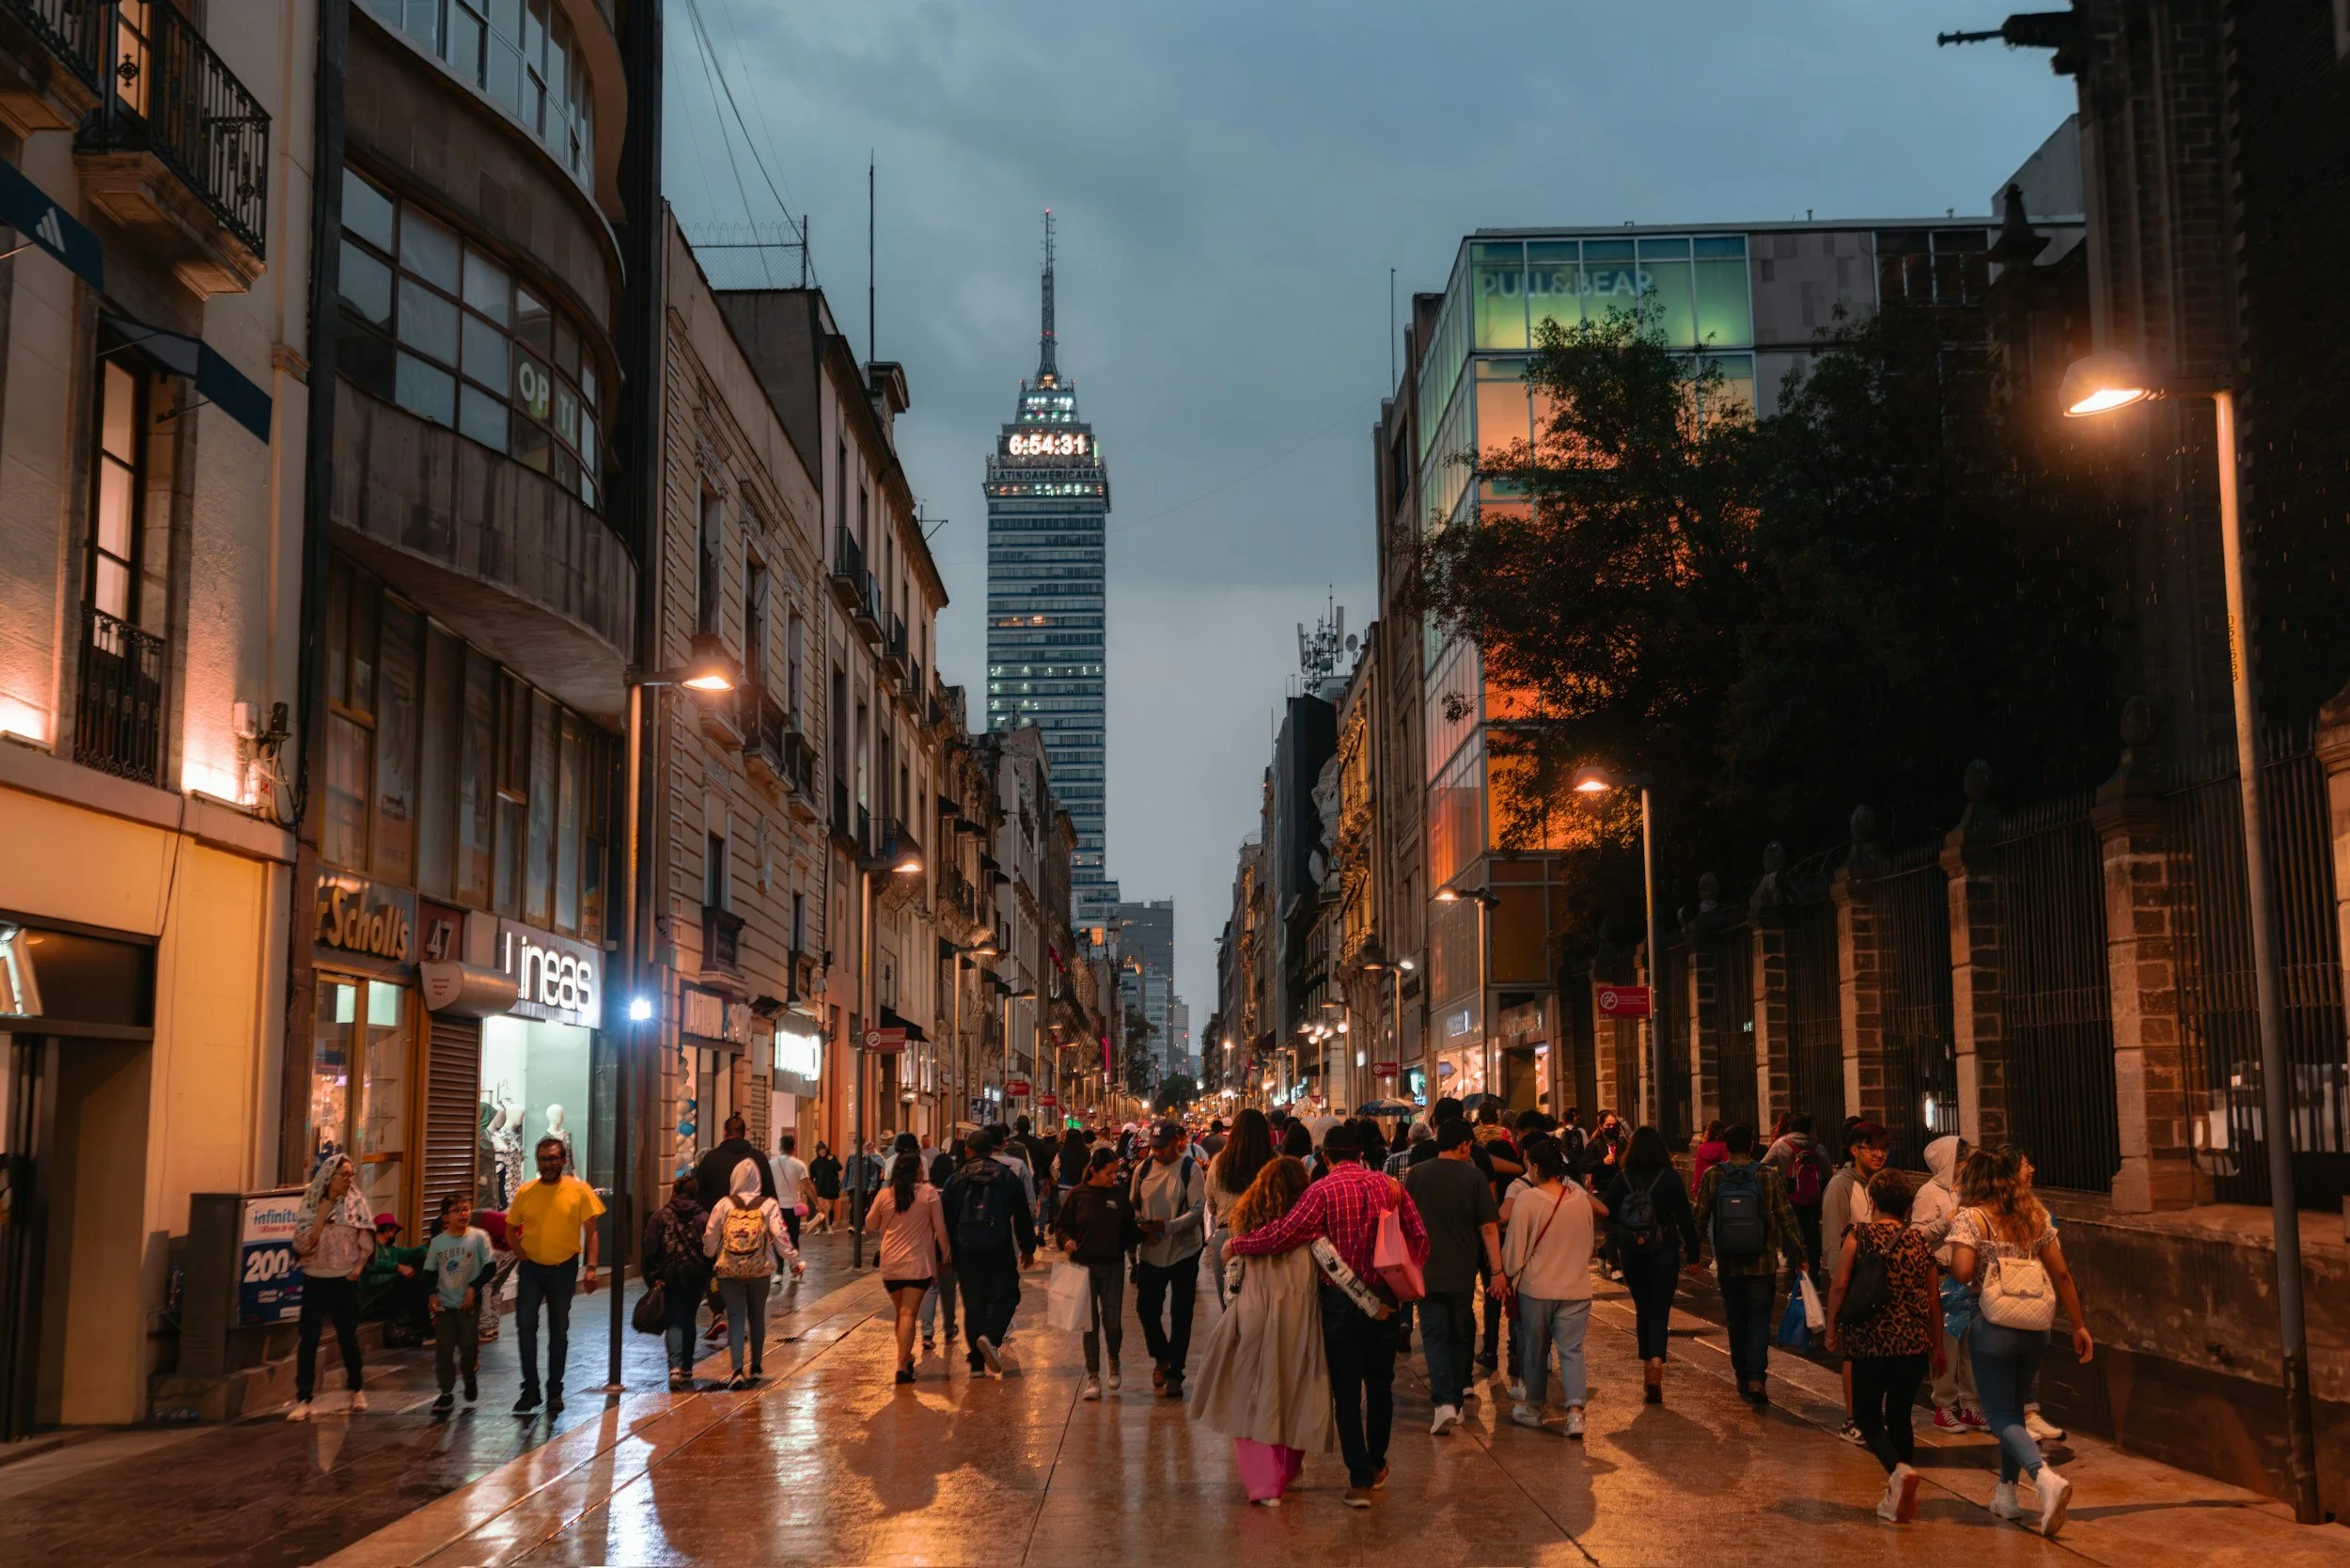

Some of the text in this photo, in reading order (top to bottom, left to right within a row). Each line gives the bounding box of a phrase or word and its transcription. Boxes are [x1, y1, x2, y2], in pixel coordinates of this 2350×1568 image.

[1480, 270, 1653, 298] PULL&BEAR
[1009, 433, 1086, 455] 6:54:31
[993, 470, 1098, 480] LATINOAMERICANA
[327, 886, 410, 961] Scholl's
[427, 918, 453, 960] 47
